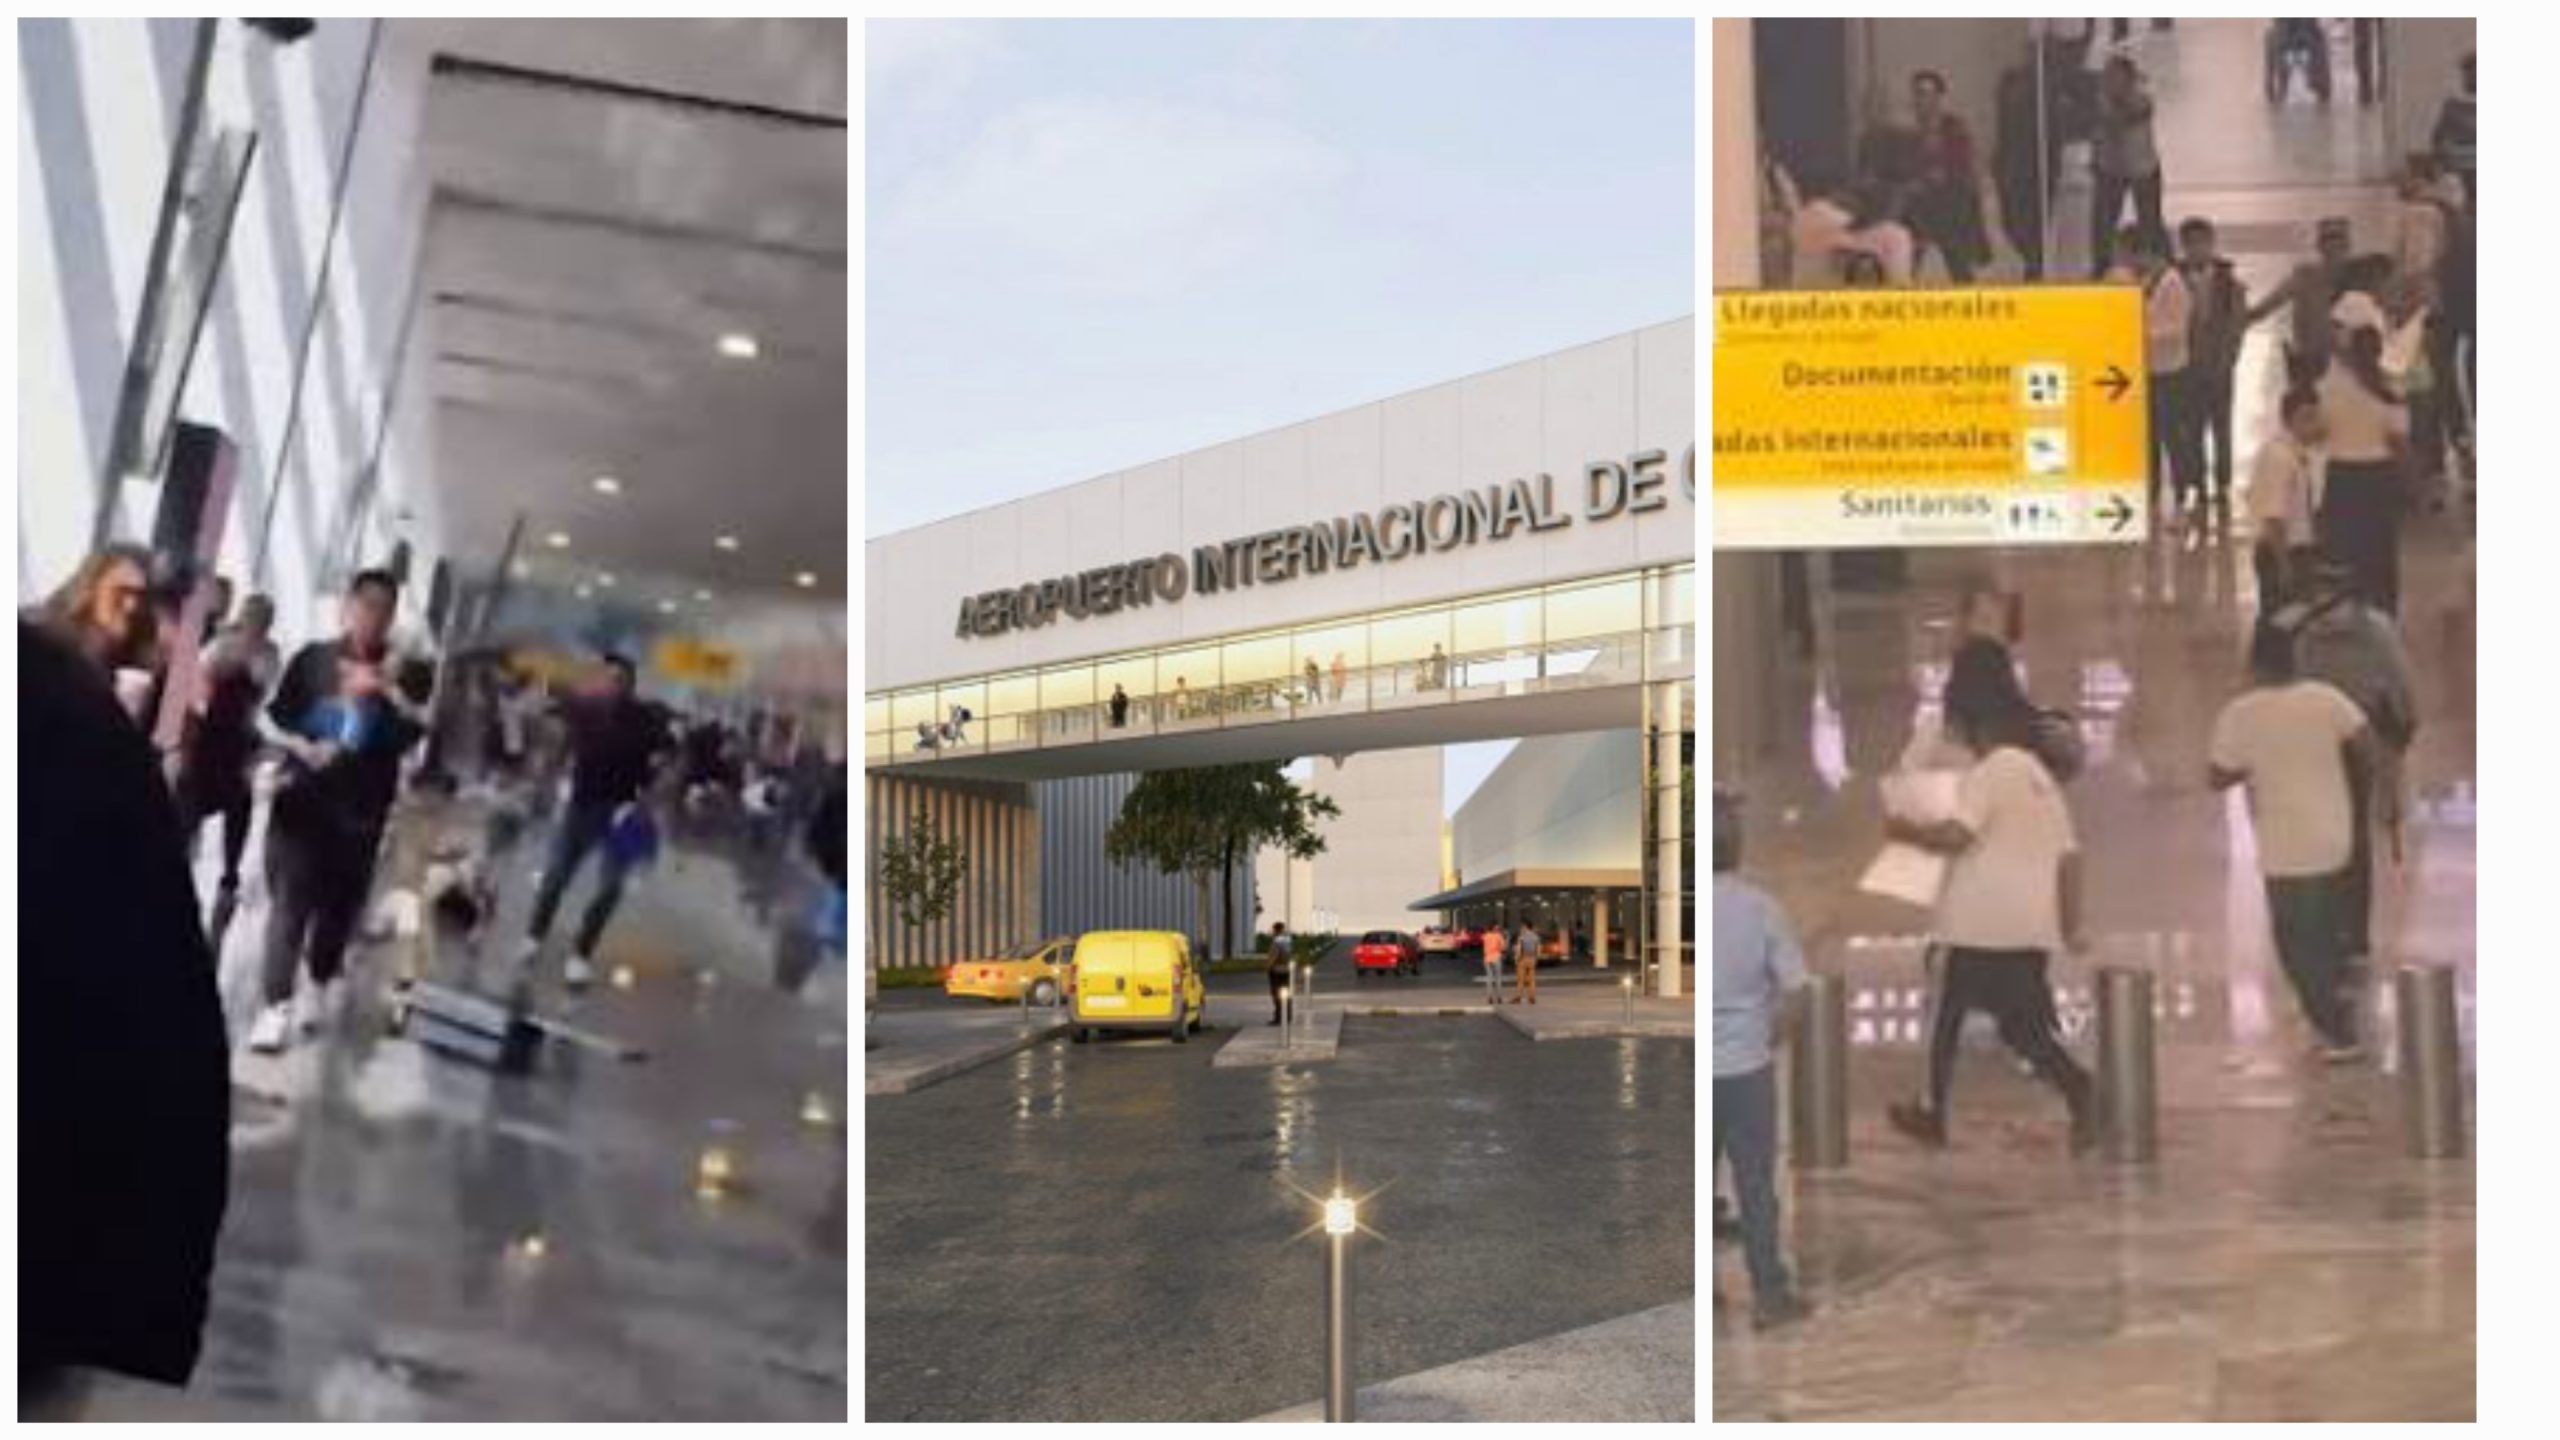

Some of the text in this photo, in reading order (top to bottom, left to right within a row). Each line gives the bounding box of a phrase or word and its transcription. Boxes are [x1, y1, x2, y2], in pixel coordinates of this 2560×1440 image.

[1860, 292, 2016, 321] nacionales
[1782, 360, 2011, 388] Documentación
[1839, 489, 1992, 517] Sanitarios
[955, 552, 1189, 640] AEROPUERTO
[1190, 474, 1572, 595] INTERNACIONAL
[1583, 448, 1668, 522] DE
